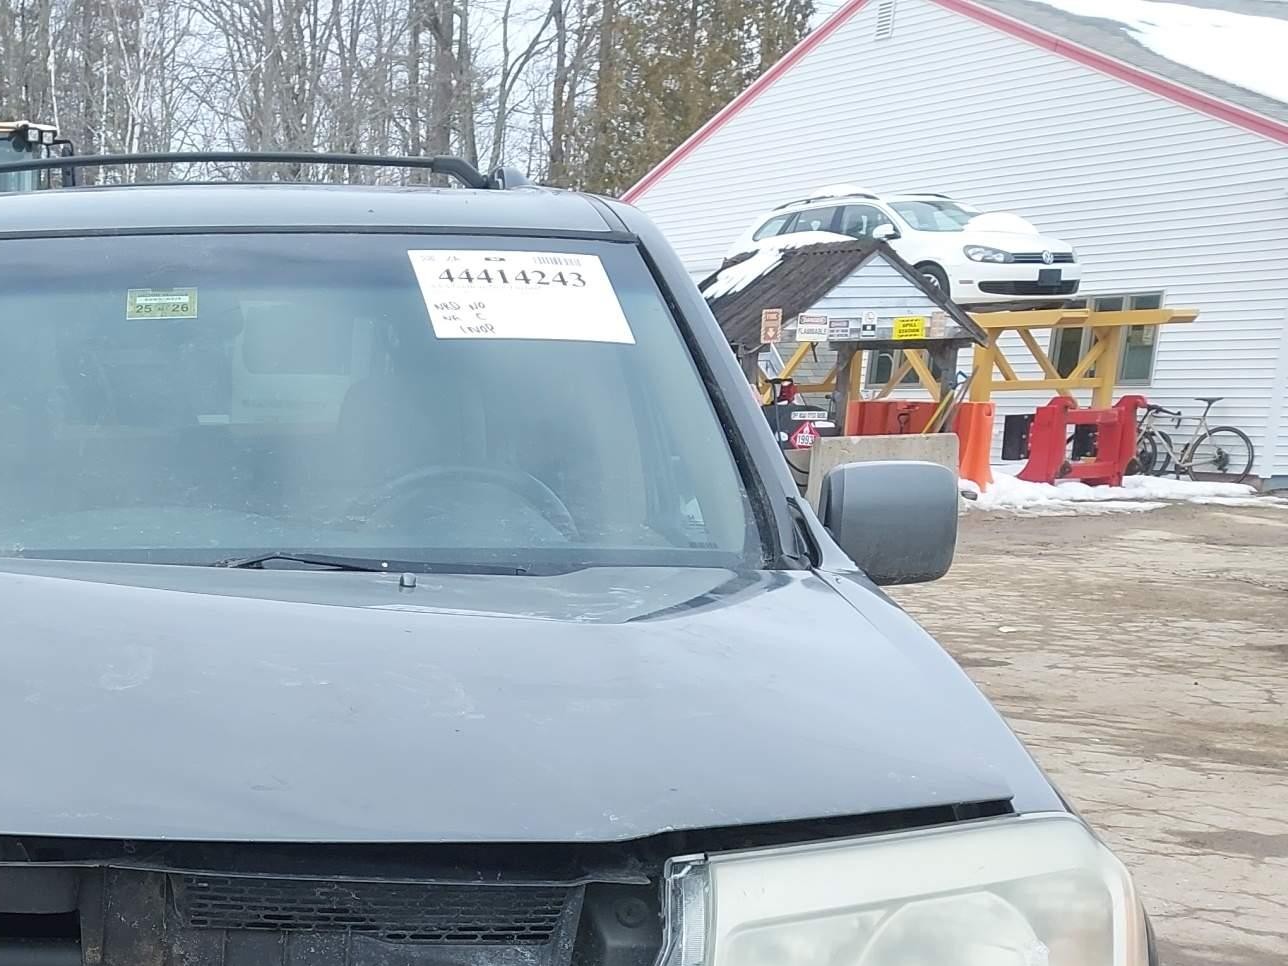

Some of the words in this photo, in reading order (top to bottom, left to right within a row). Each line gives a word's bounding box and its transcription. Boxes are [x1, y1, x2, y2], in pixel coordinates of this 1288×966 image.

[438, 268, 587, 288] 44414243
[135, 304, 153, 313] 25
[171, 303, 189, 312] 26
